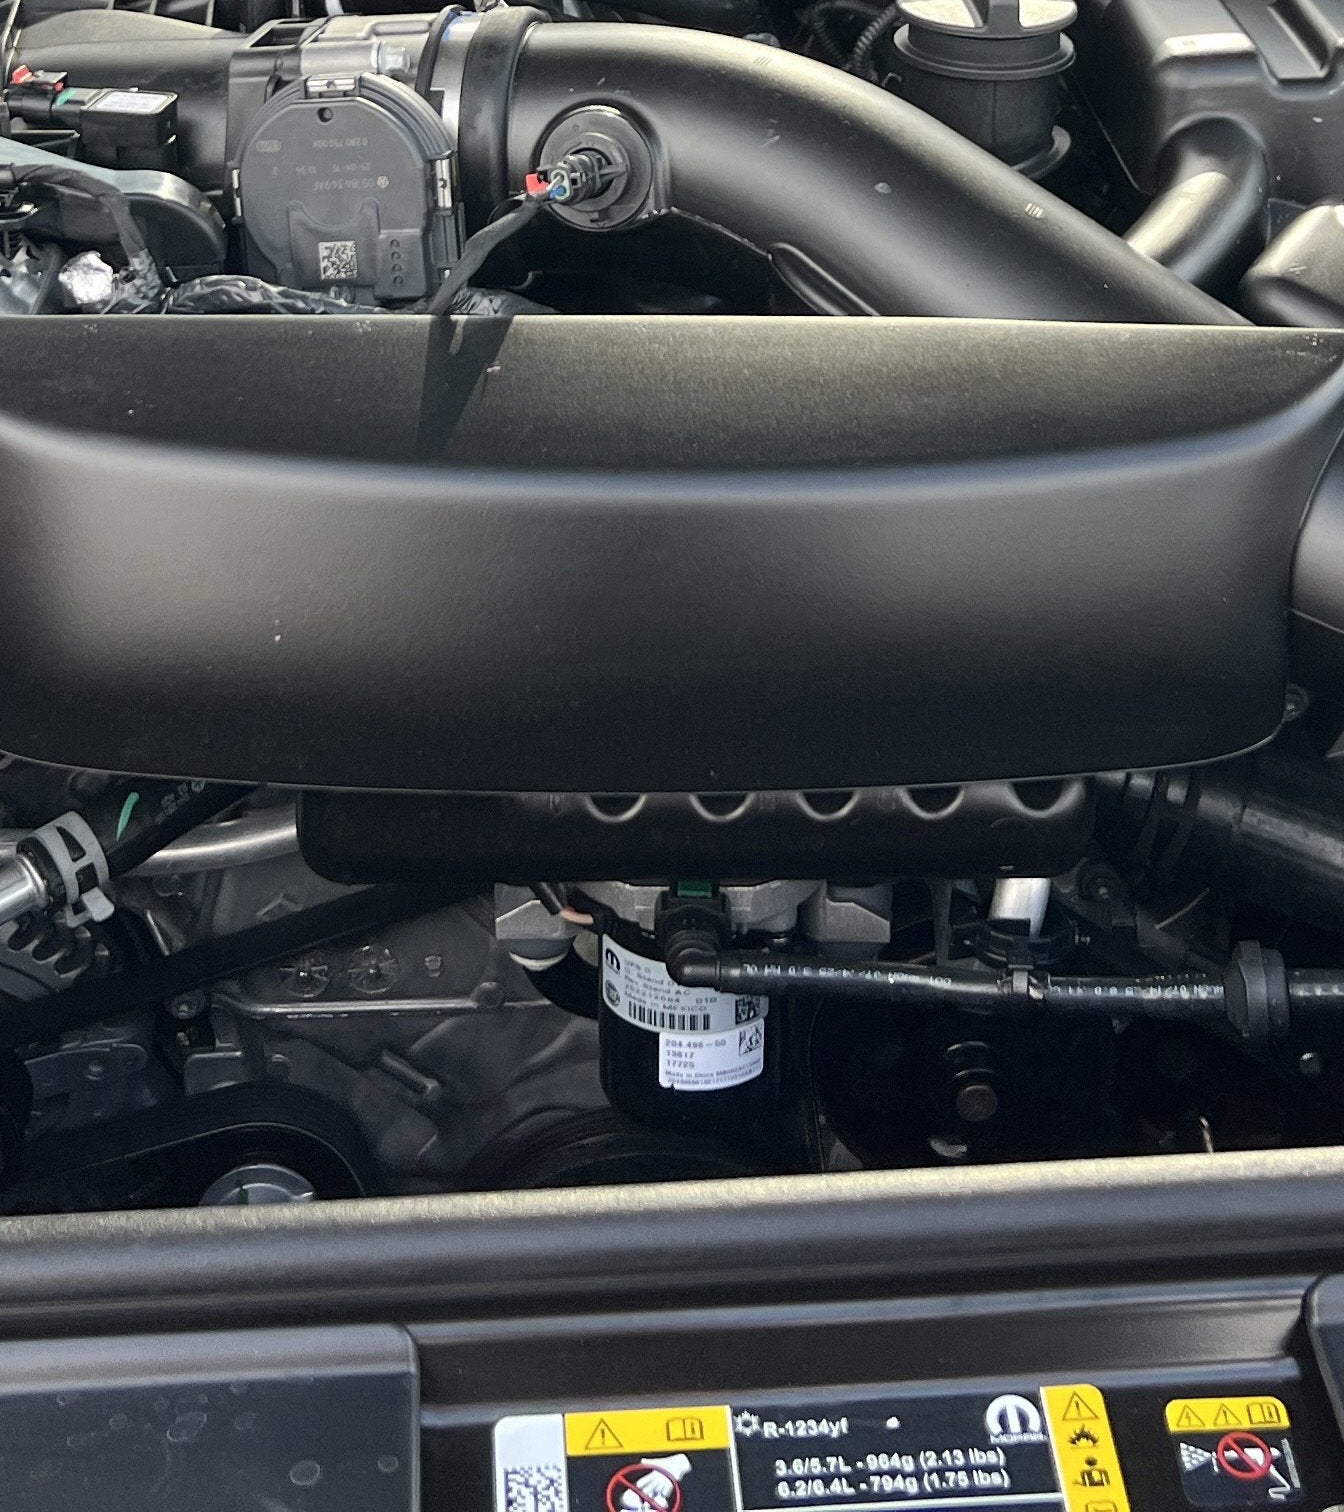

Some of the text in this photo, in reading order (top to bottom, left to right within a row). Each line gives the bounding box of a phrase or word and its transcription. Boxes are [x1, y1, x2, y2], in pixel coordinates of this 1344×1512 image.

[763, 1417, 849, 1439] R-1234yf
[775, 1455, 853, 1477] 3.6/5.7L
[867, 1452, 915, 1474] 964g
[919, 1448, 965, 1470] (2.13
[968, 1446, 1007, 1467] lbs)
[776, 1477, 857, 1499] 6.2/6.4L
[868, 1474, 919, 1495] 794g
[923, 1471, 968, 1493] (1.75
[972, 1468, 1012, 1489] lbs)
